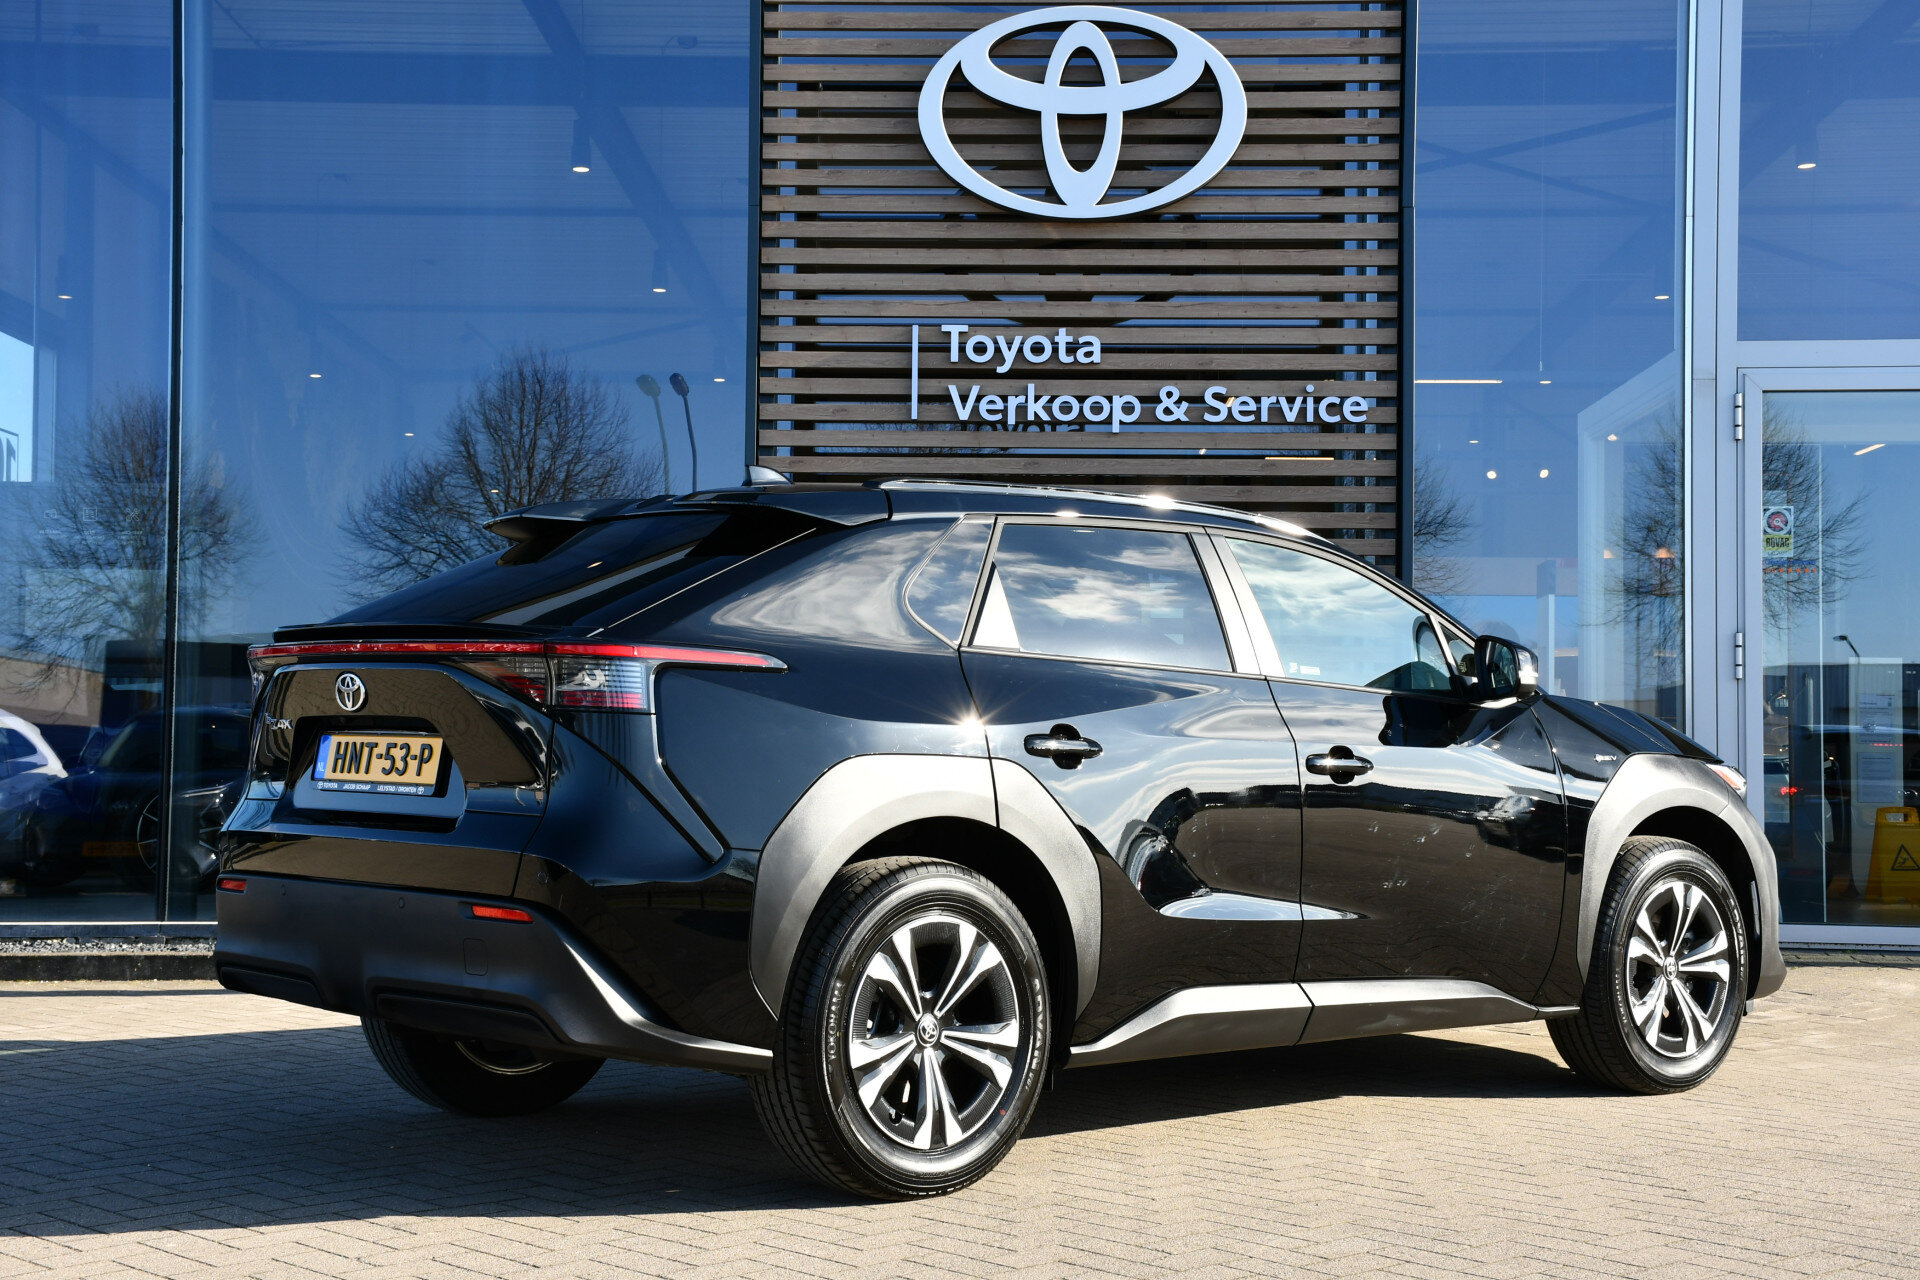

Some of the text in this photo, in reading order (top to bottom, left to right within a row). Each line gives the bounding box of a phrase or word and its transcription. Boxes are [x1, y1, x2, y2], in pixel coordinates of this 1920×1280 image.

[941, 324, 1102, 373] Toyota
[948, 383, 1369, 433] Verkoop & Service
[1765, 537, 1790, 548] BOVAG
[316, 761, 325, 772] NL
[332, 741, 433, 776] HNT-53-P
[828, 980, 845, 1061] YOKOHAMA
[1033, 979, 1044, 1070] ADVAN
